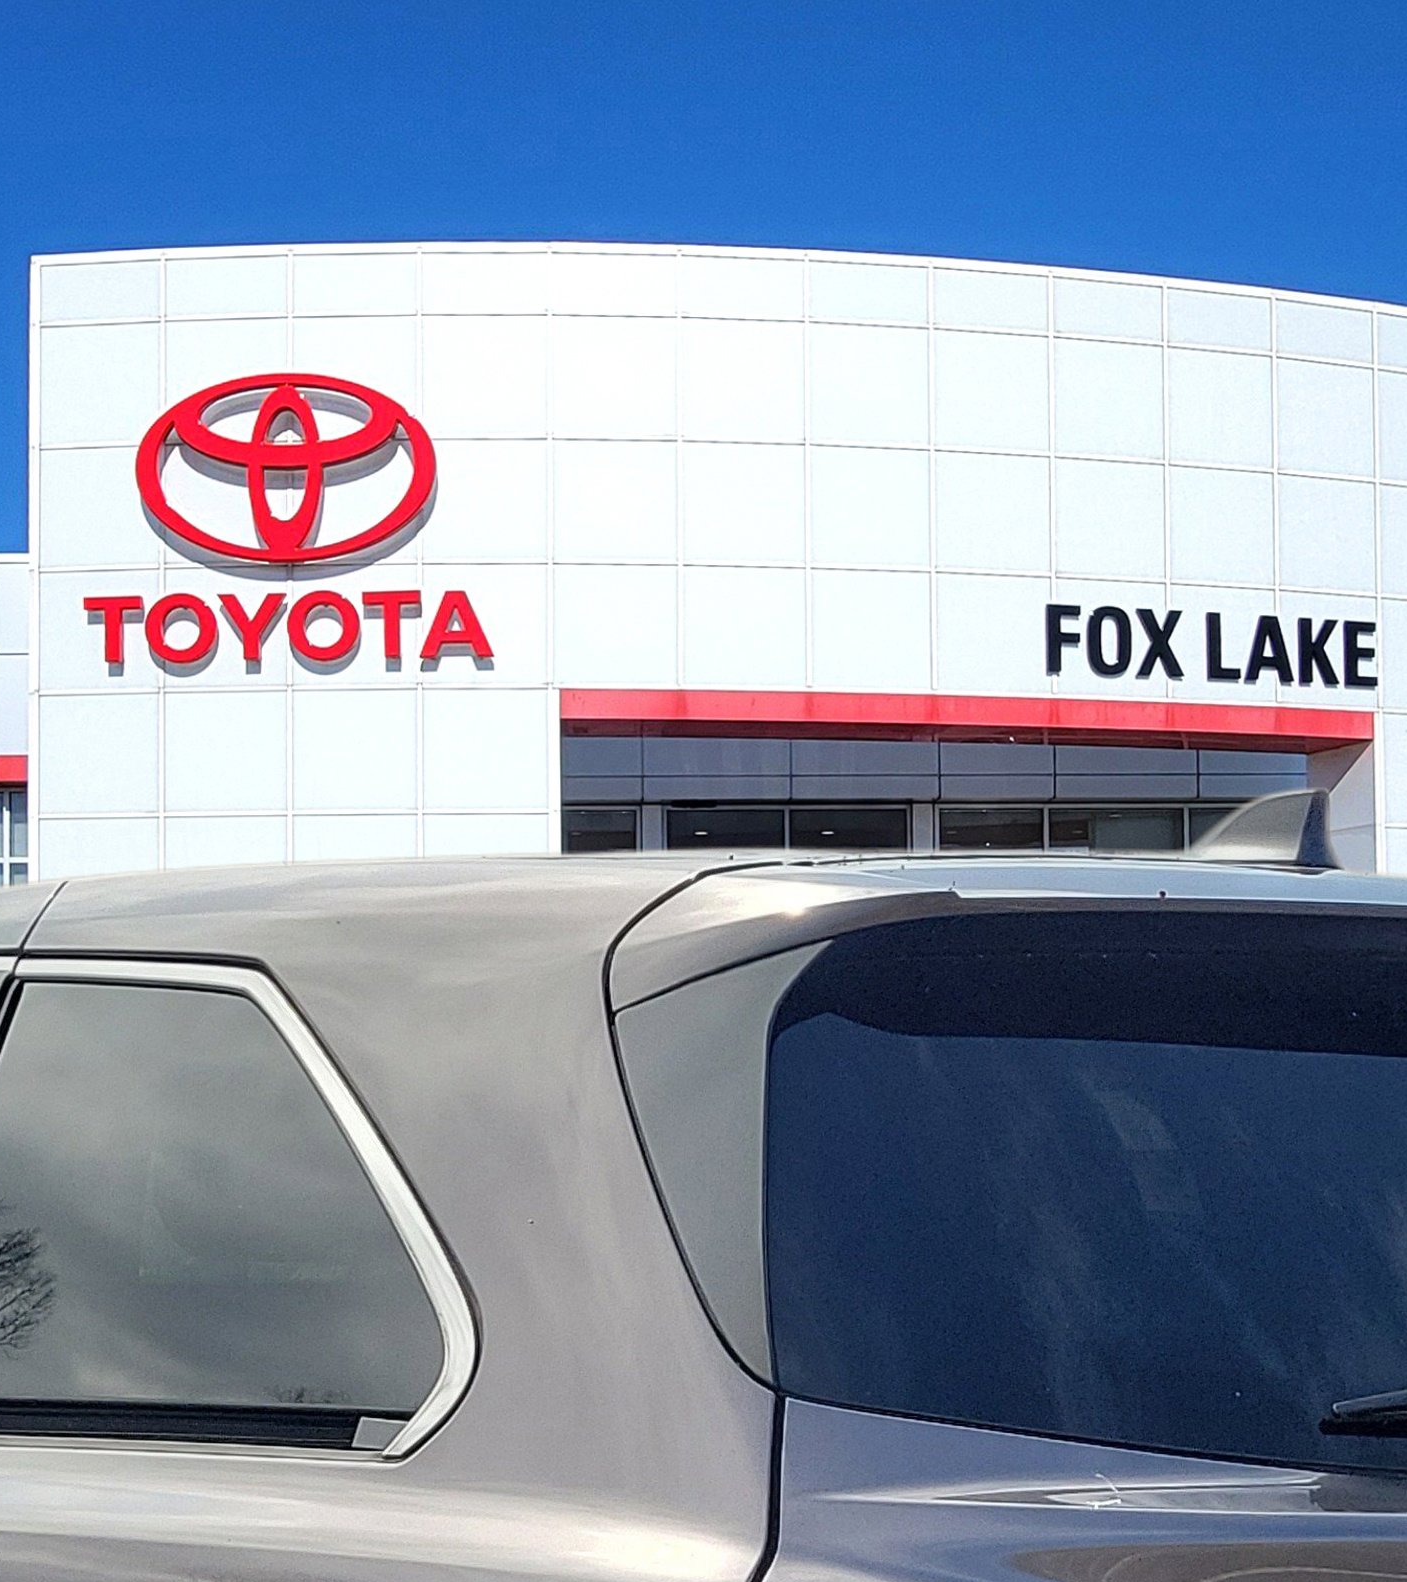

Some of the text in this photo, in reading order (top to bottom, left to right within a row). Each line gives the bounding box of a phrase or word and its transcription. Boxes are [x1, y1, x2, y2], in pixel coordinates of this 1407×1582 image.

[83, 590, 495, 665] TOYOTA
[1045, 603, 1379, 690] FOX LAKE
